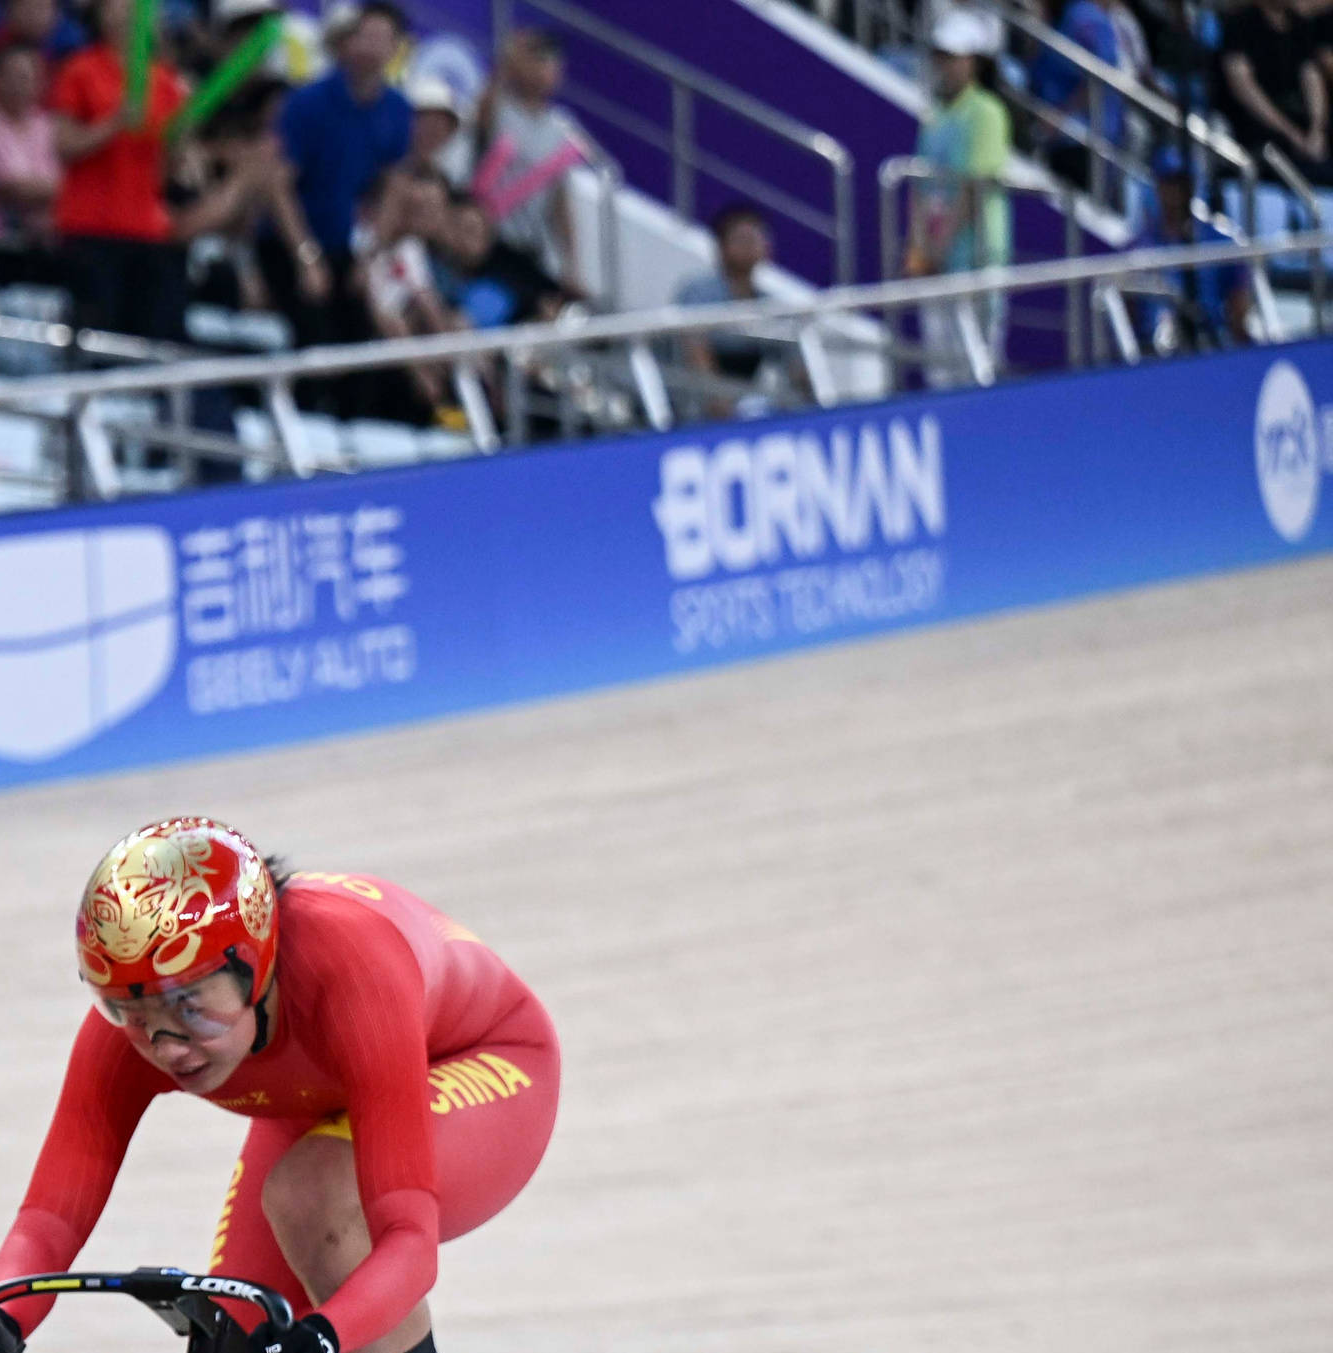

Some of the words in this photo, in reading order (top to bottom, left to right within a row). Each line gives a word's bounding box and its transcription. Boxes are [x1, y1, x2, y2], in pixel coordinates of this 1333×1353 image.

[653, 414, 947, 580] BORNAN
[312, 623, 415, 691] AUTO
[181, 1277, 263, 1302] LOOK
